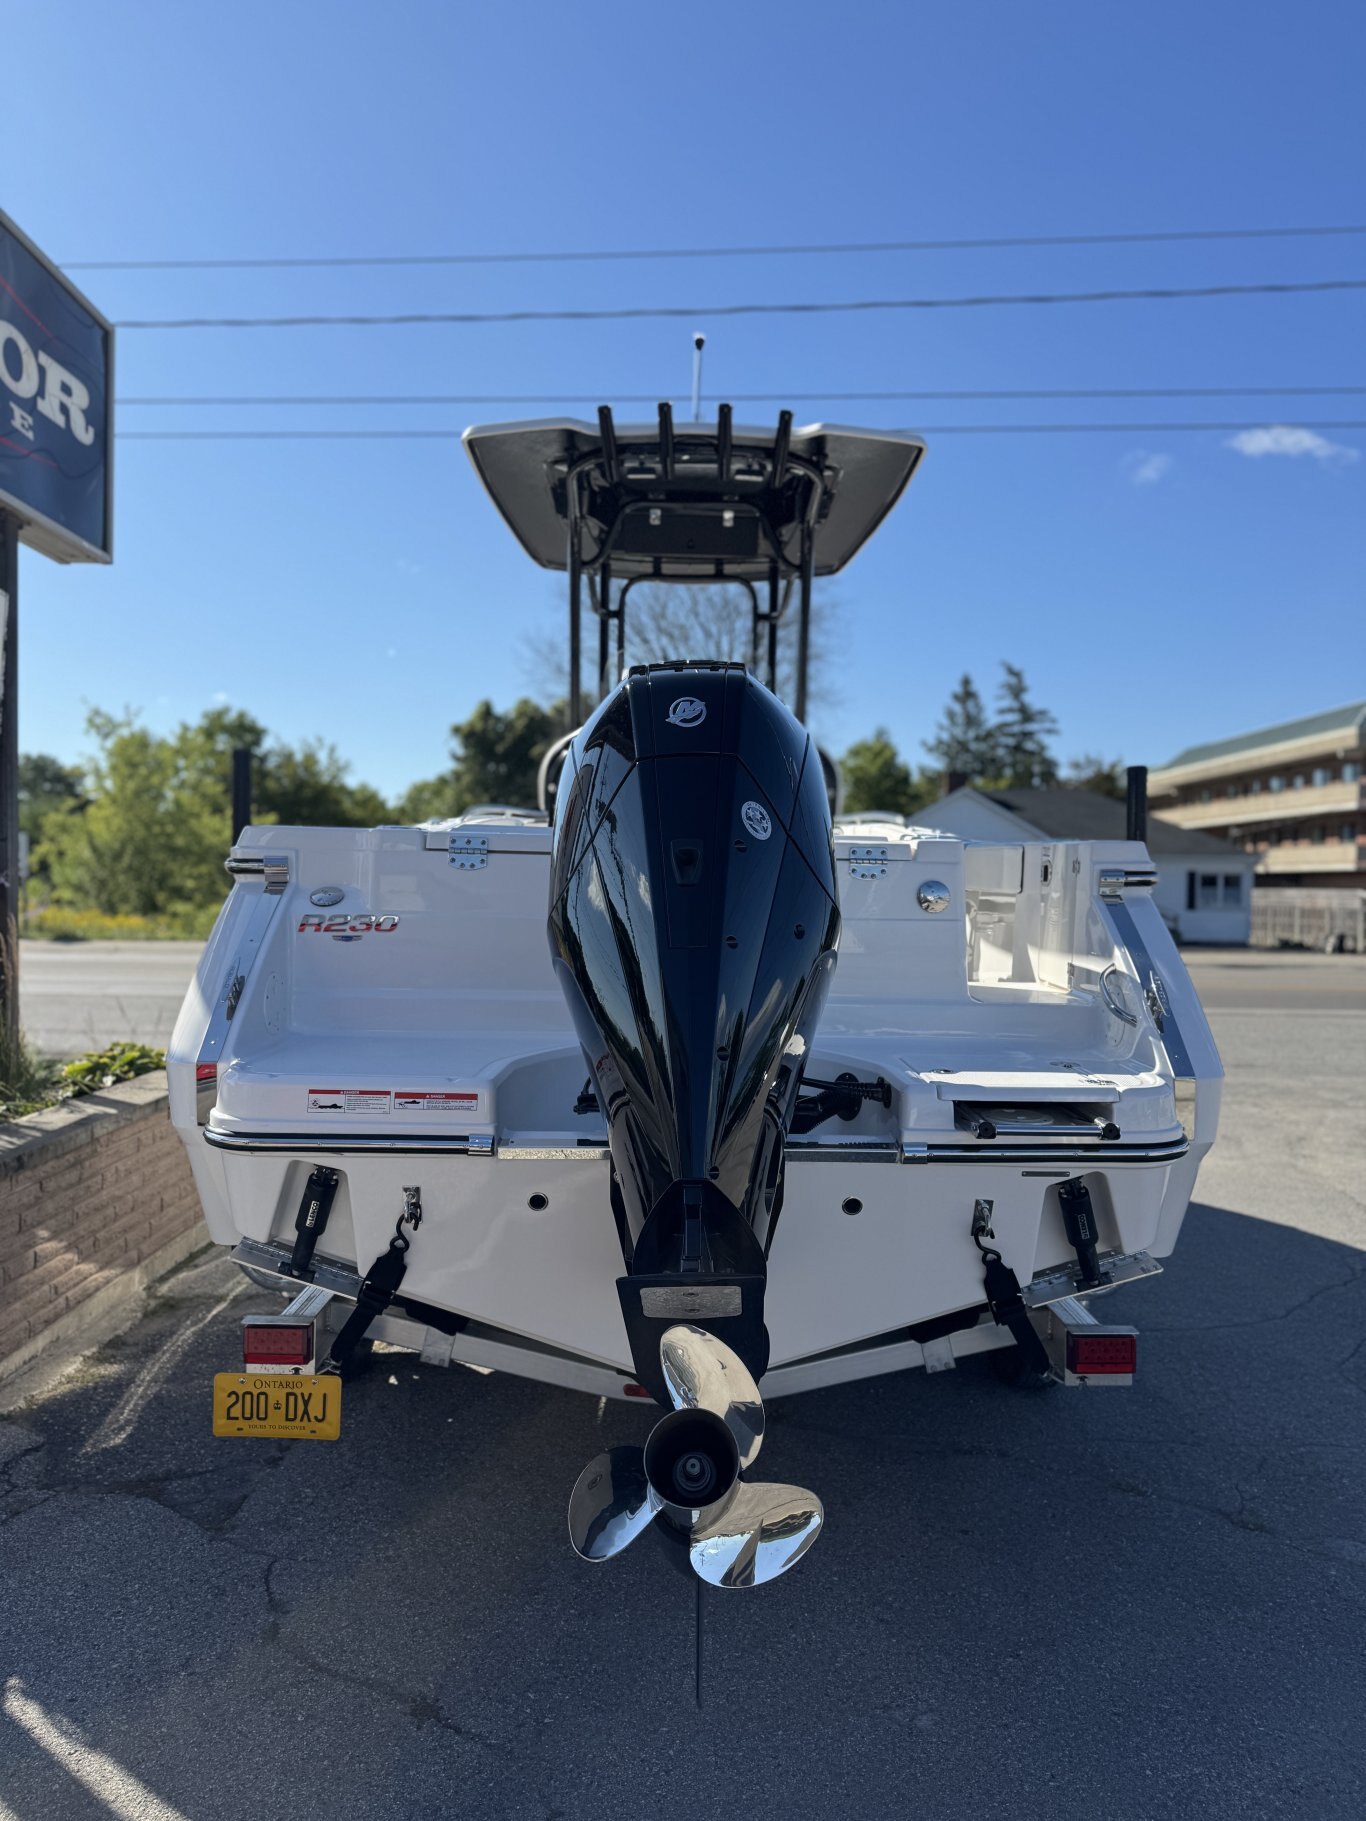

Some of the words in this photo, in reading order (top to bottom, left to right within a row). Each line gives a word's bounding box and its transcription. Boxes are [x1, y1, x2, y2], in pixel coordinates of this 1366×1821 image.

[298, 914, 400, 932] R230
[1079, 1215, 1088, 1235] LENCO
[226, 1390, 268, 1421] 200
[285, 1391, 327, 1423] DXJ
